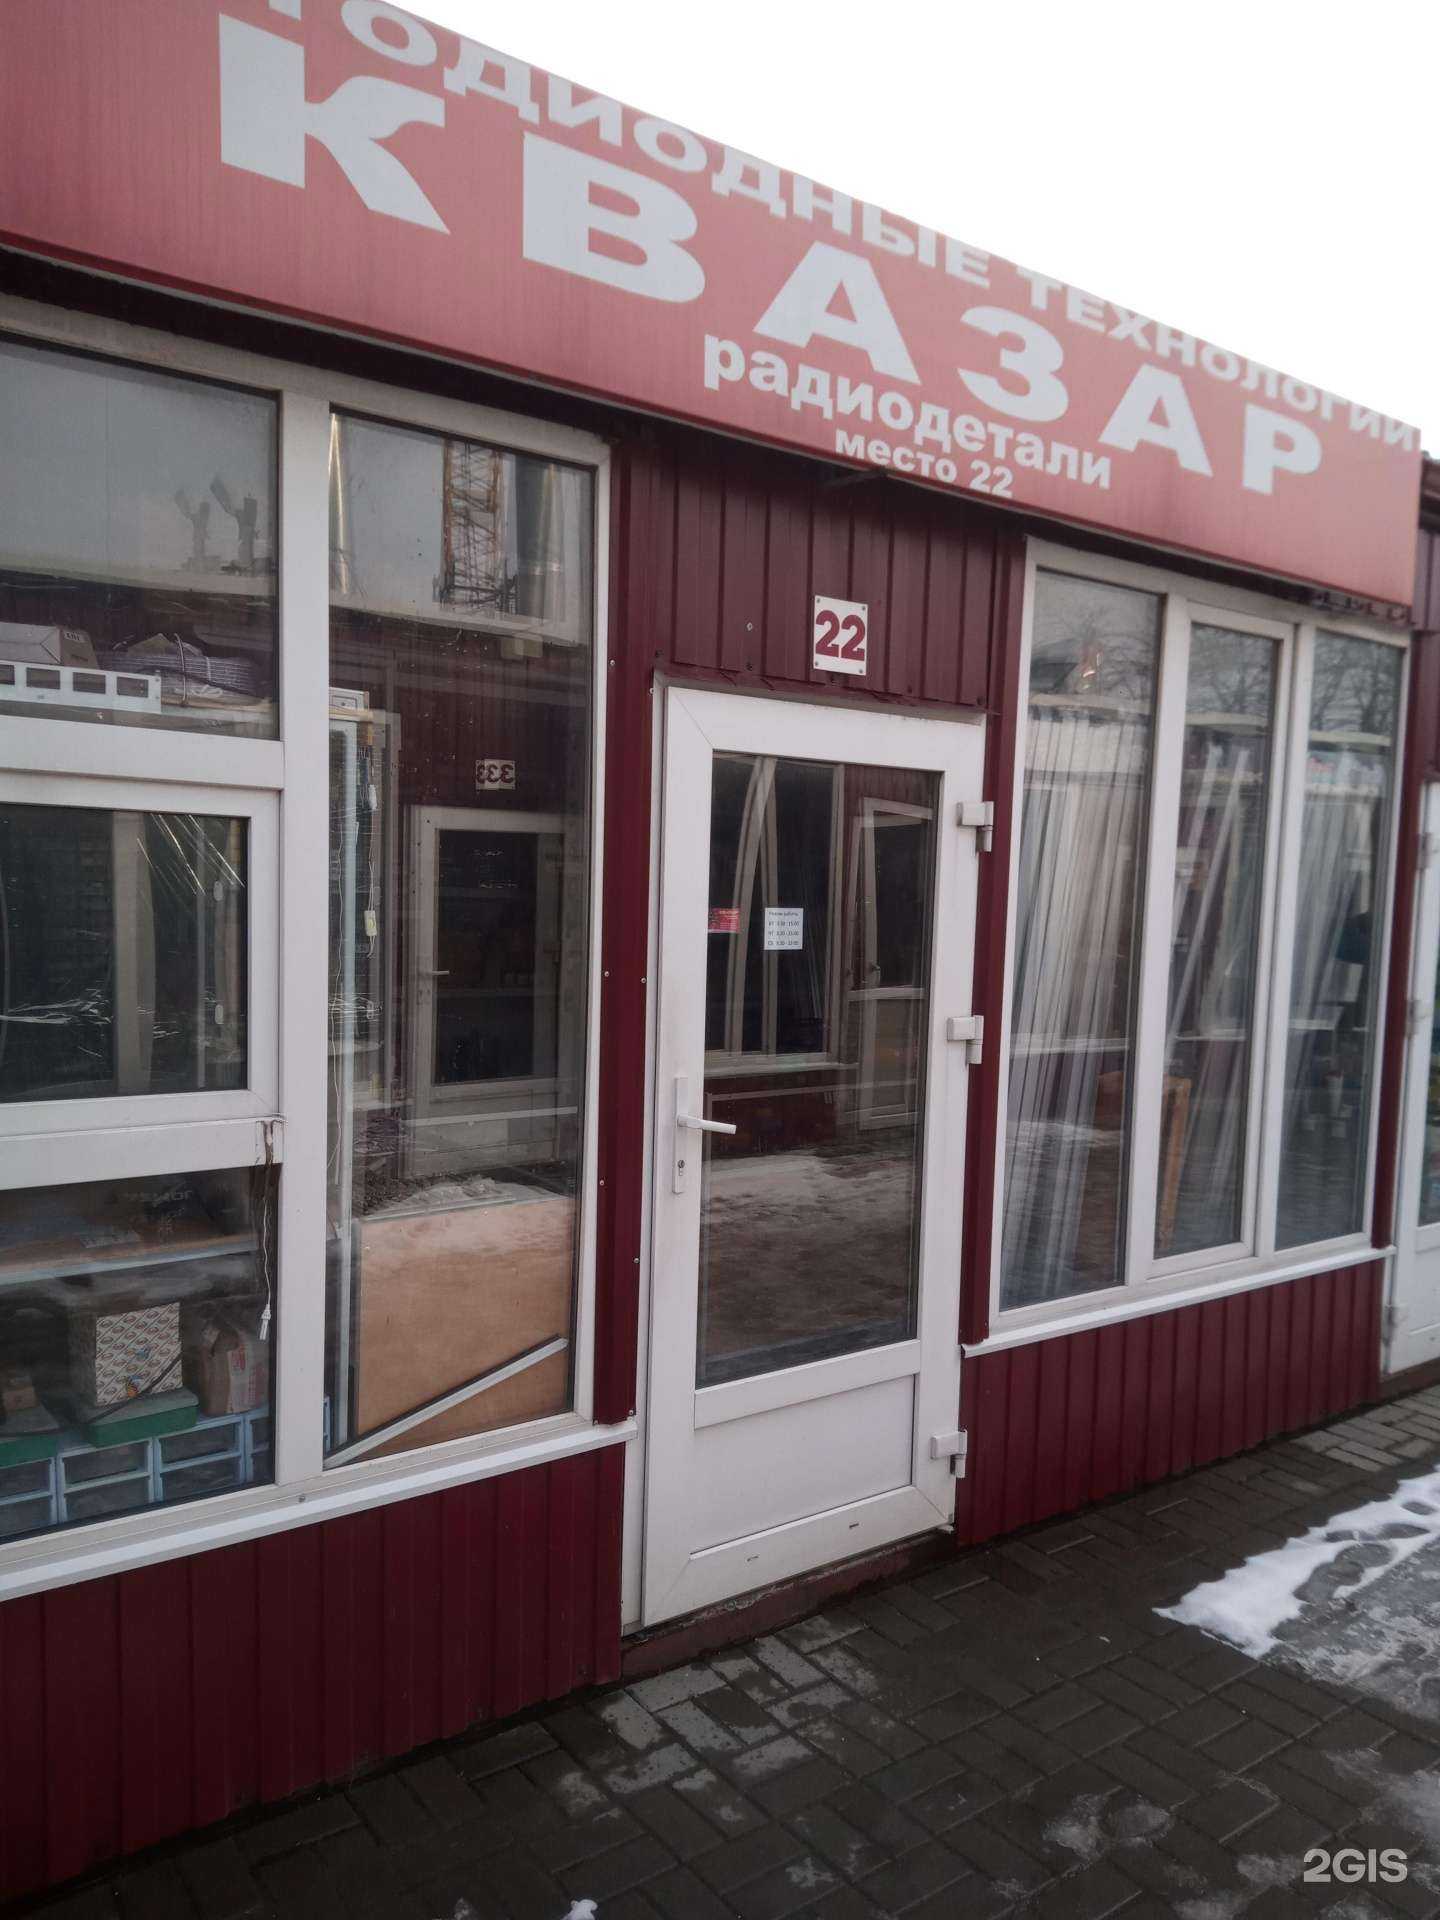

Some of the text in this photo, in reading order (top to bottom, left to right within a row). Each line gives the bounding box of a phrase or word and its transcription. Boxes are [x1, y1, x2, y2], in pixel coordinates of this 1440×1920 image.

[217, 12, 1324, 496] КВАЗАР
[268, 0, 1416, 452] ОДИОДНЫЕ ТЕХНОЛОГИИ
[703, 333, 1113, 490] радиодетали
[834, 428, 1014, 498] место 22
[815, 609, 866, 662] 22
